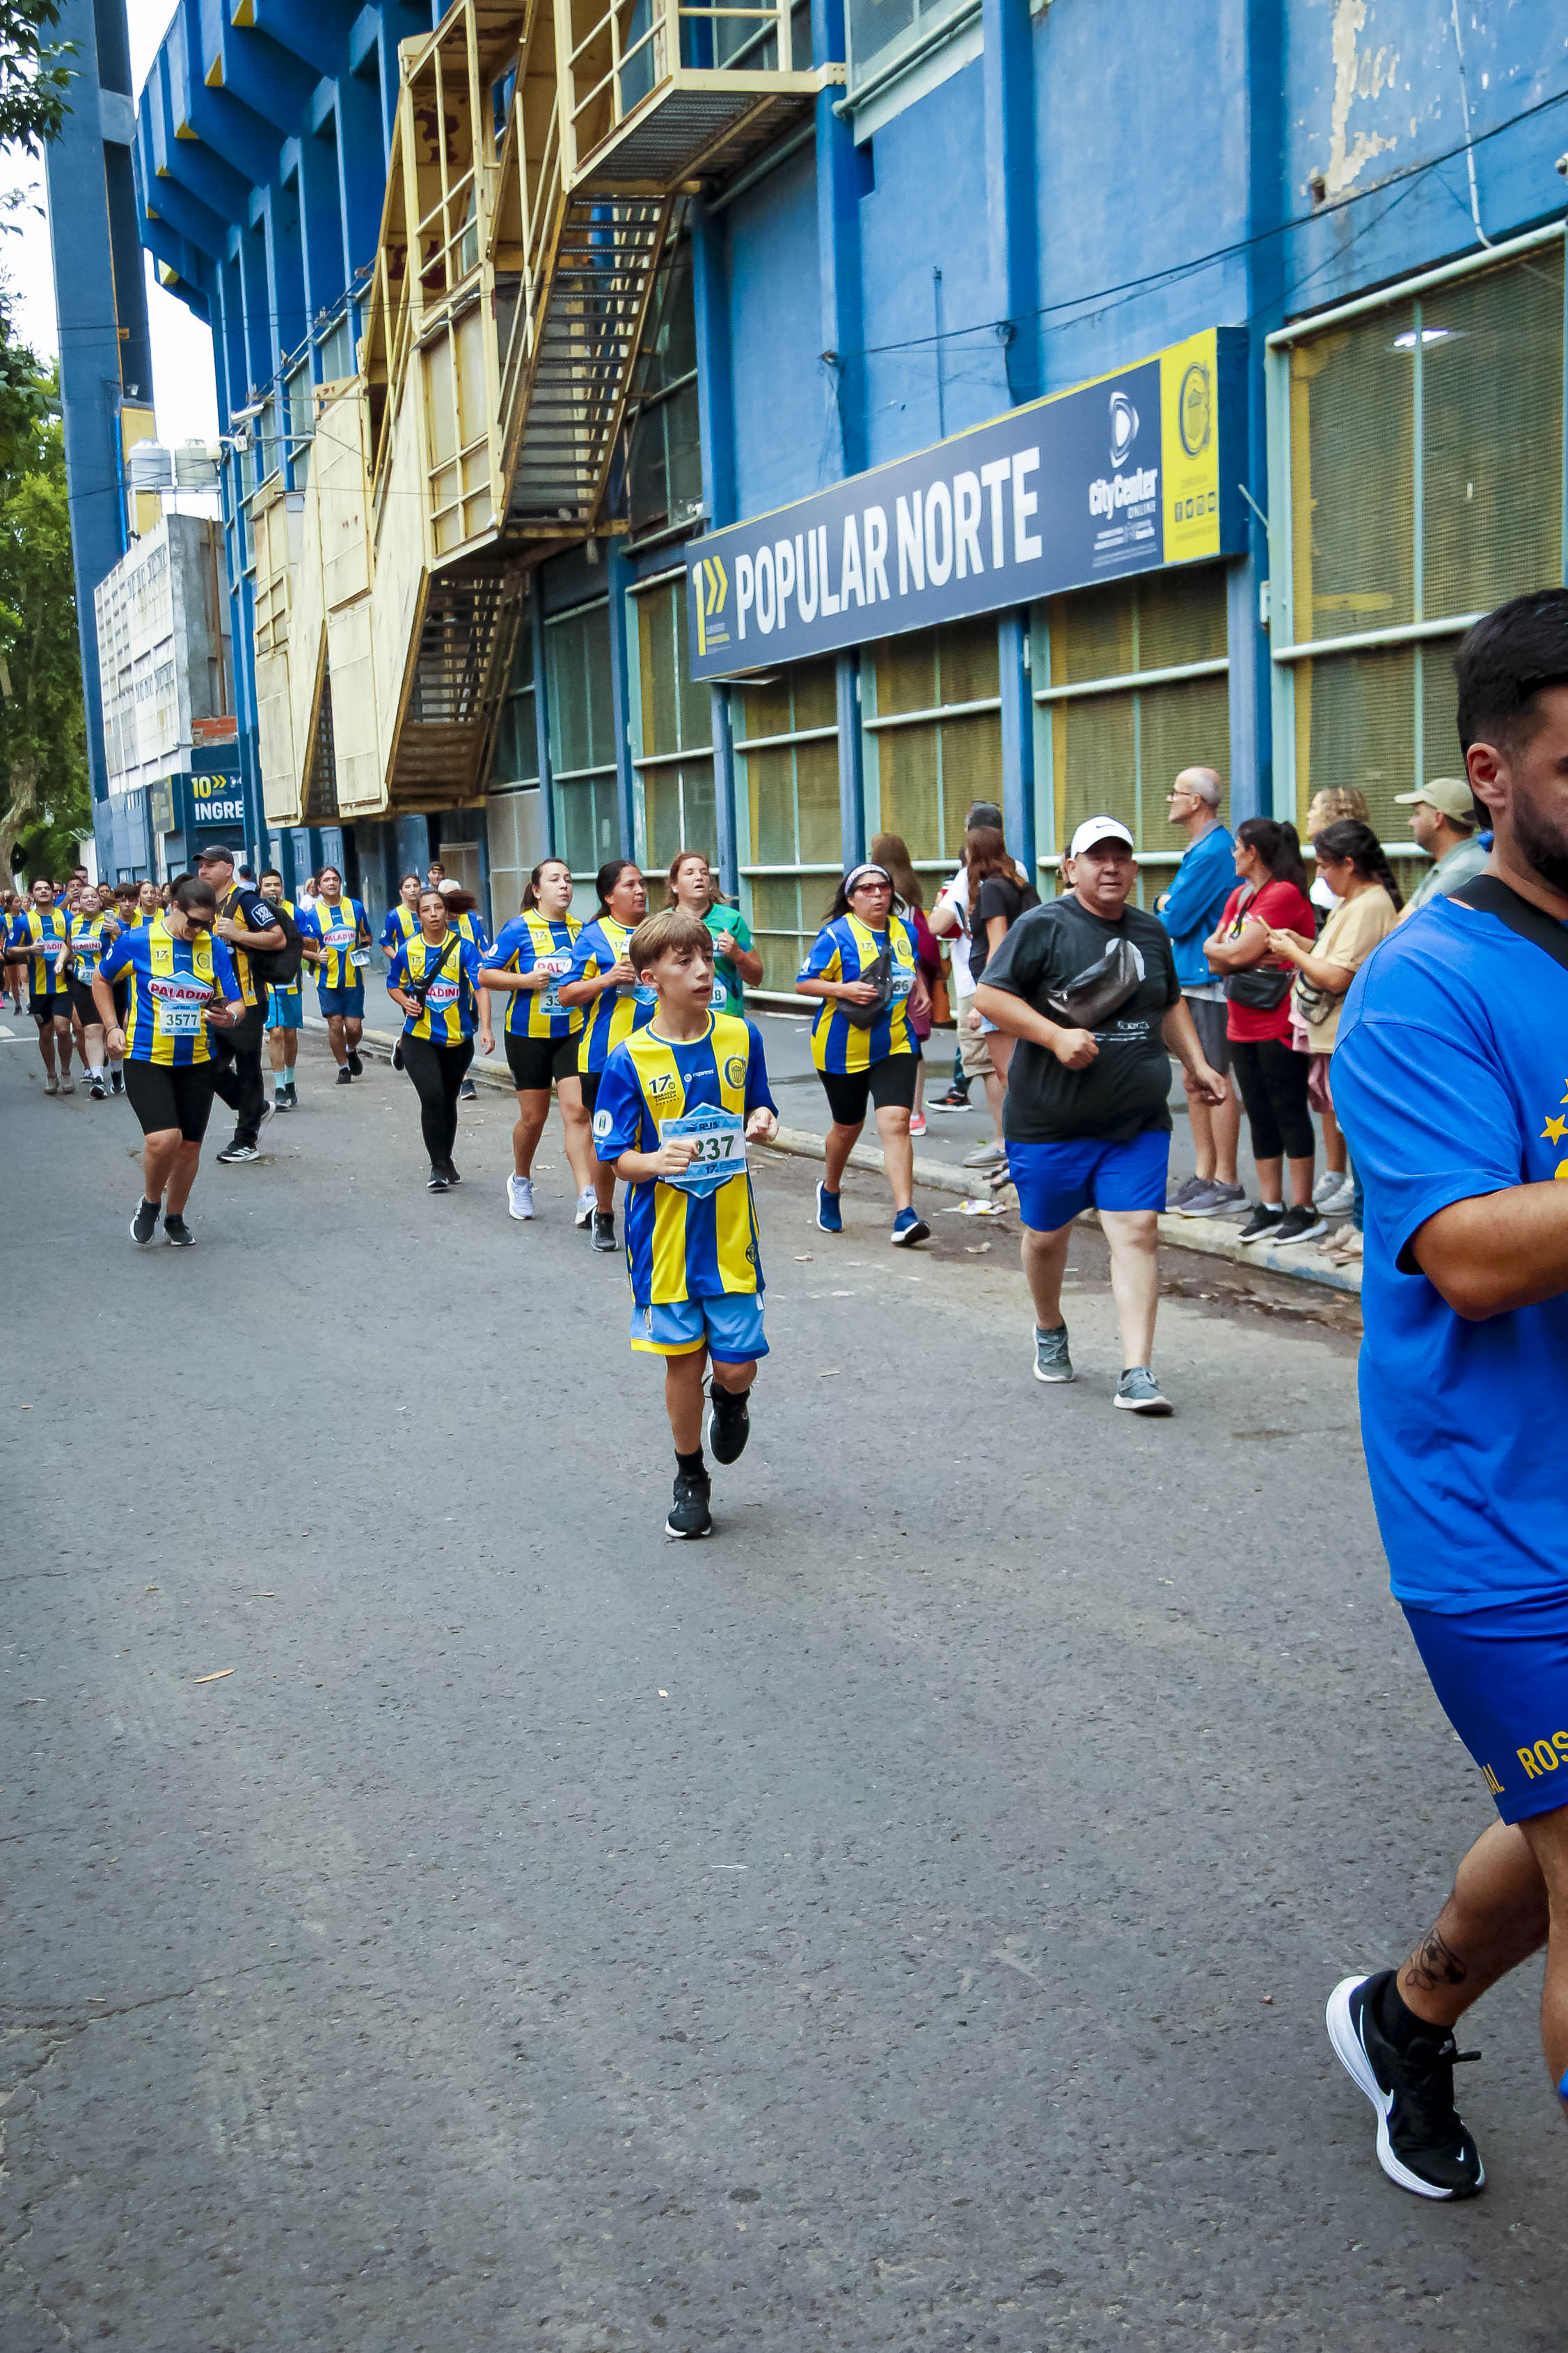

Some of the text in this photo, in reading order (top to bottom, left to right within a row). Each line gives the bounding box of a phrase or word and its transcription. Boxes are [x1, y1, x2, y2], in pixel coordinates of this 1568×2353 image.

[735, 505, 890, 640] POPULAR
[896, 446, 1043, 595] NORTE
[191, 776, 212, 798] 10
[166, 1014, 198, 1026] 3577
